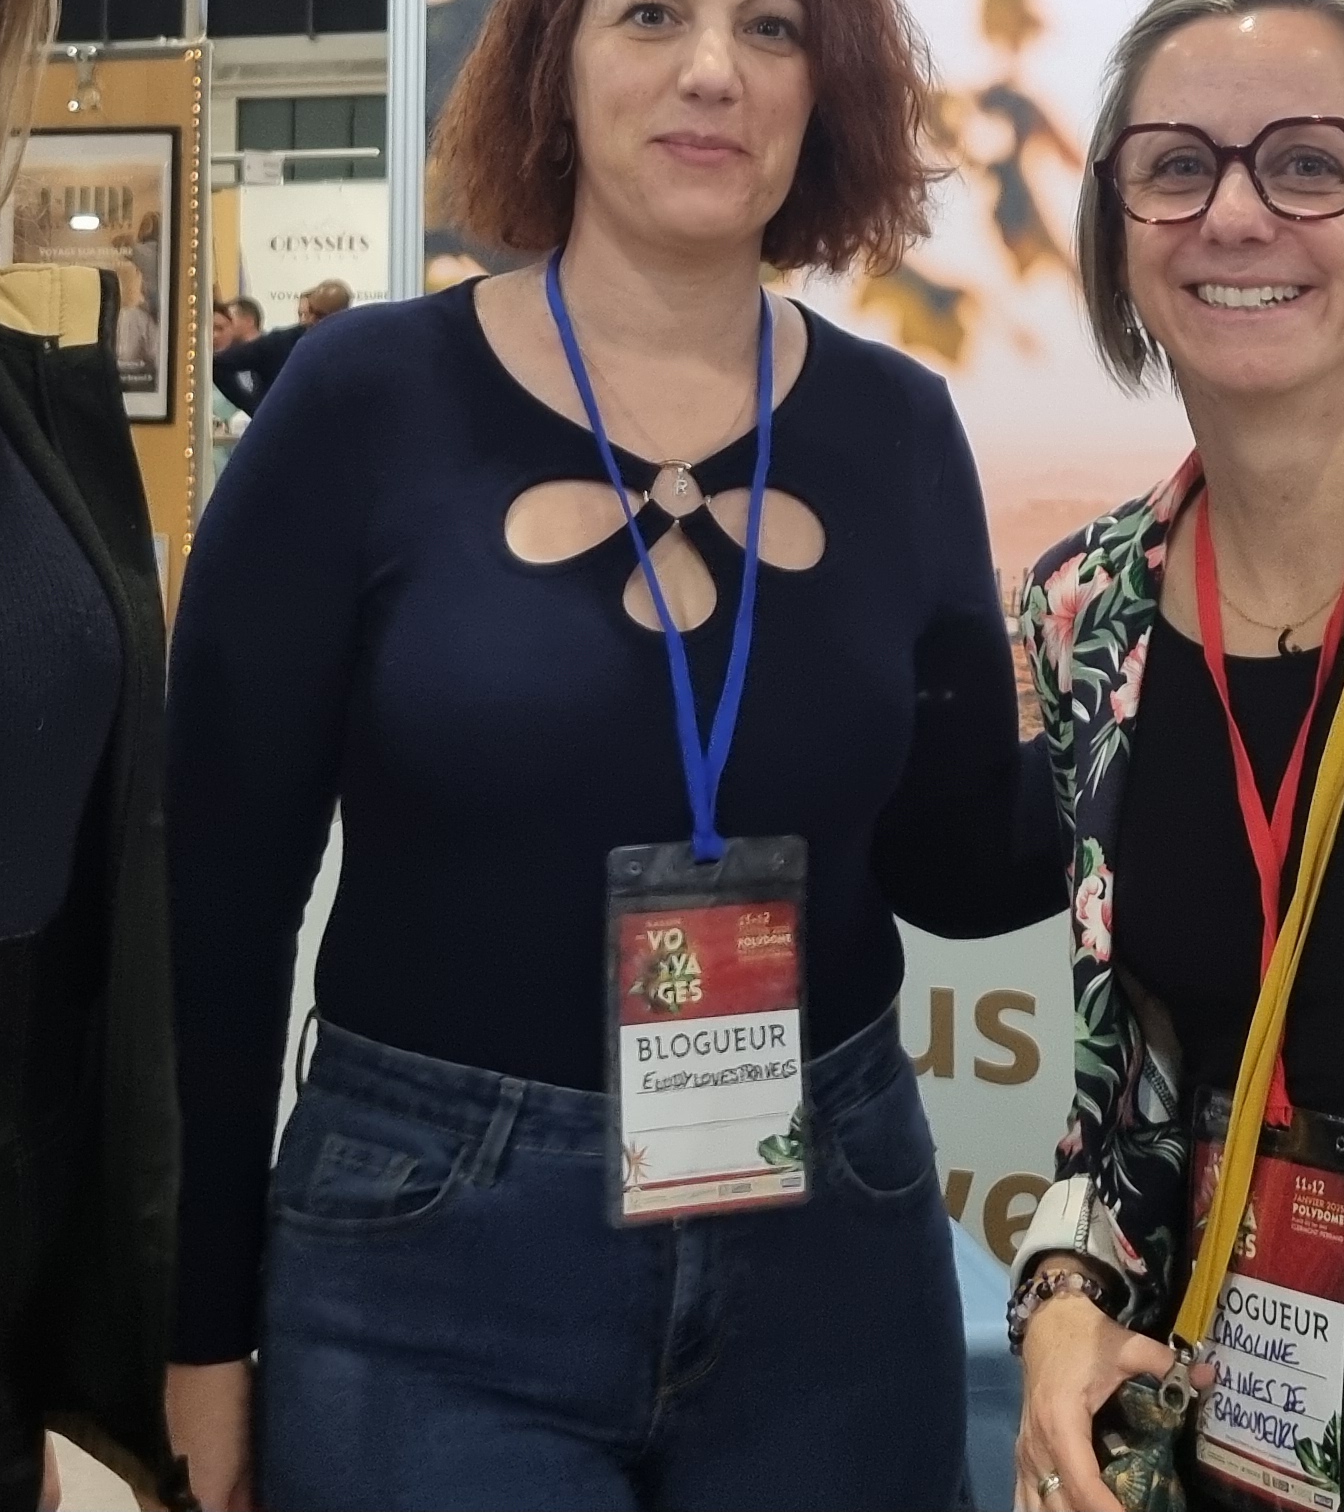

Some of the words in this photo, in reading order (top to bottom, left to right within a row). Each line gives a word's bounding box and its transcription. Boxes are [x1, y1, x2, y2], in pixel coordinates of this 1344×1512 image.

[270, 291, 304, 302] VOYA
[647, 928, 684, 951] VO
[657, 979, 703, 1004] GES
[637, 1024, 786, 1062] BLOGUEUR
[1293, 1193, 1325, 1208] JANVIER
[1292, 1202, 1344, 1226] POLYDOME
[1216, 1286, 1328, 1342] LOGUEUR
[1213, 1312, 1299, 1364] CAROLINE
